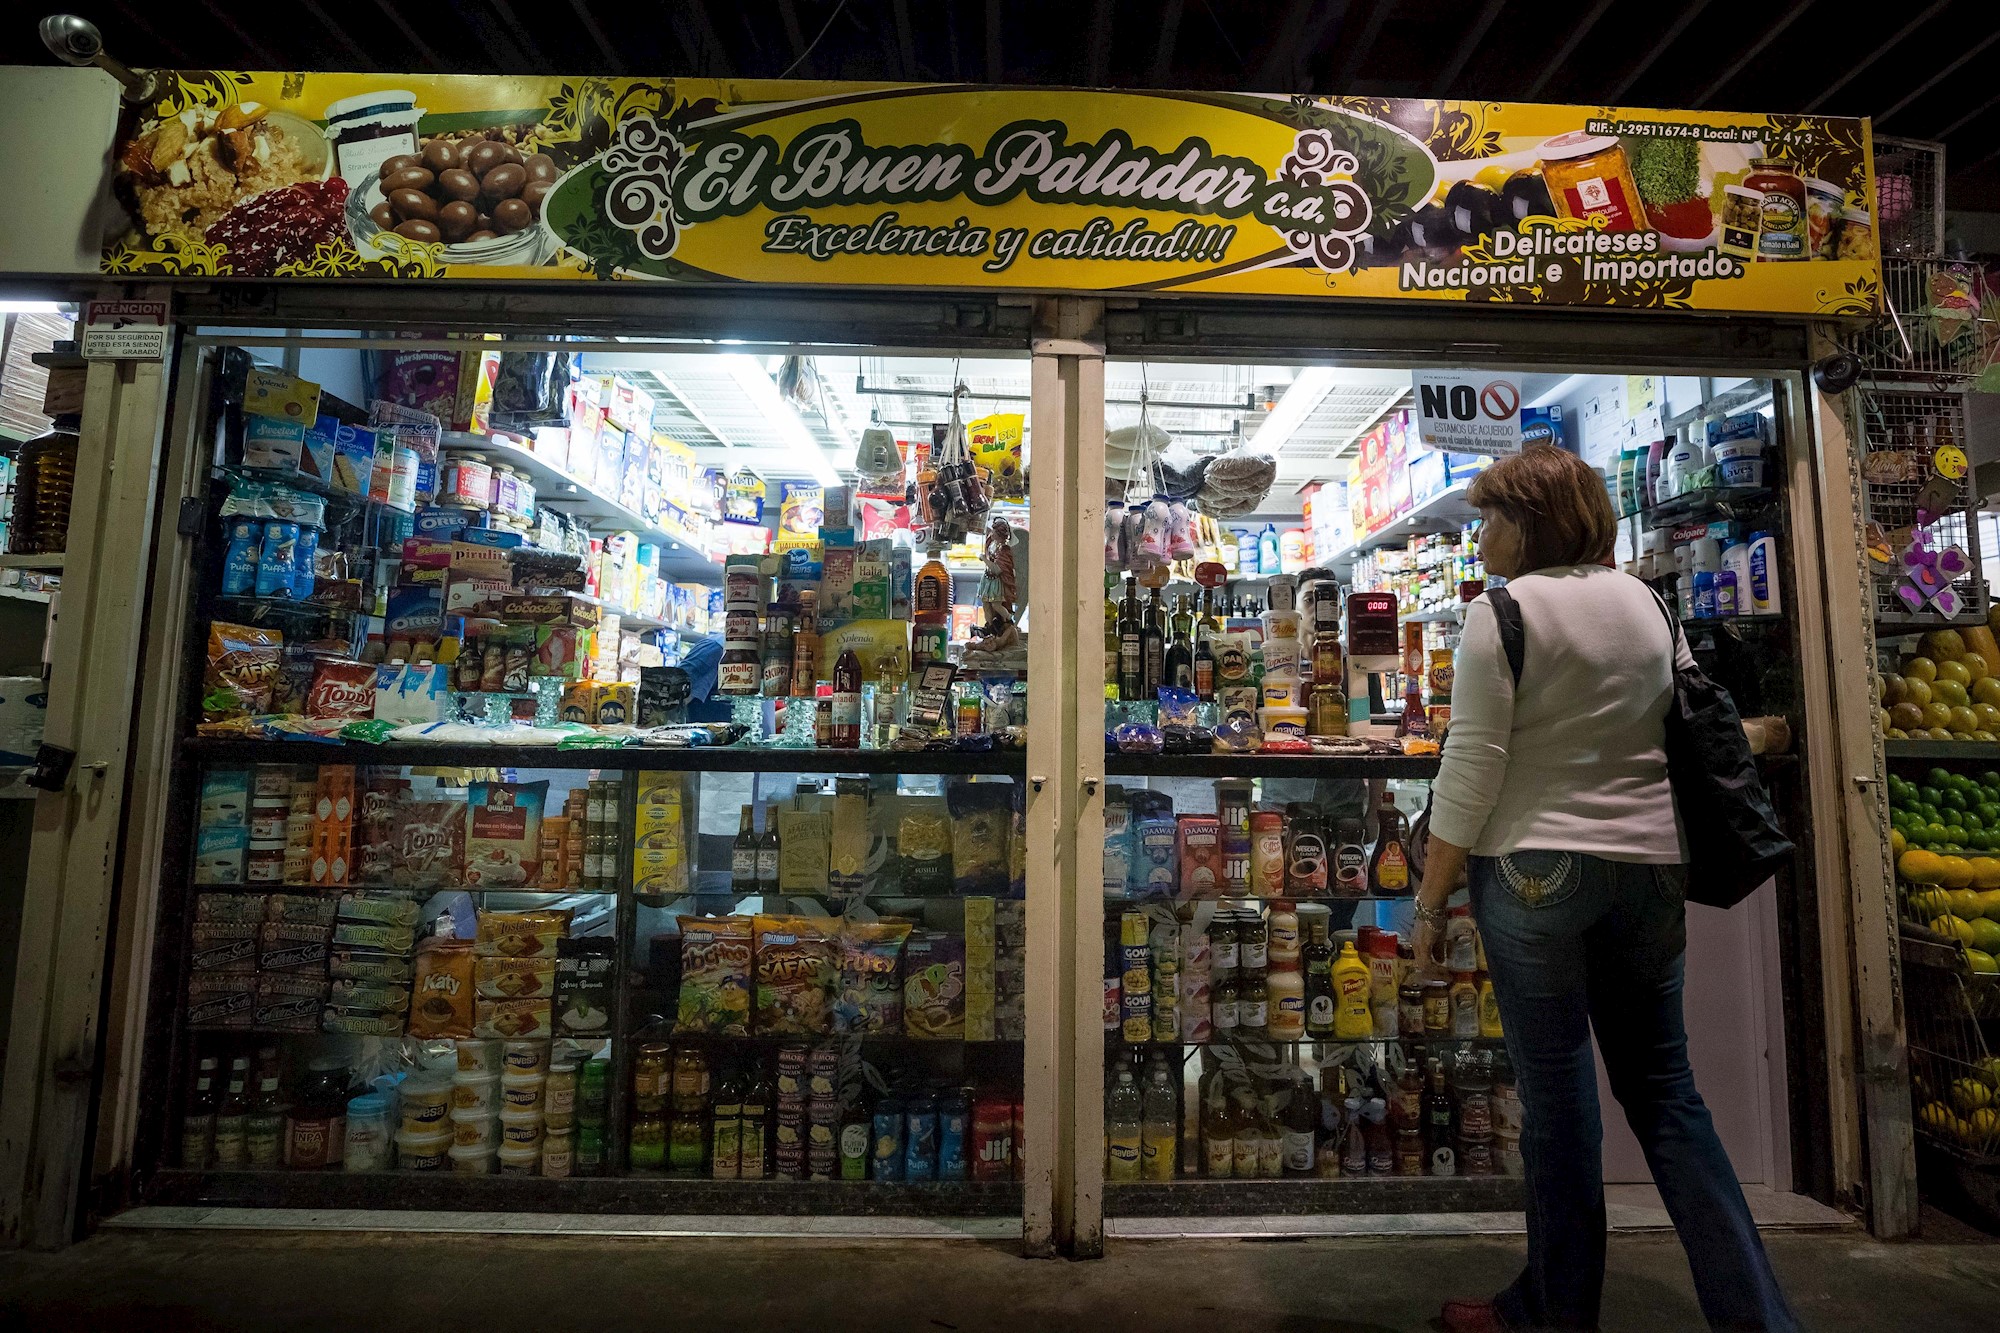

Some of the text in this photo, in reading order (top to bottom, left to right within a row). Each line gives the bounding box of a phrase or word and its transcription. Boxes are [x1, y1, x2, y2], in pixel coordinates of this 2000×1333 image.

[1617, 124, 1700, 138] J-29511674-8
[1704, 128, 1737, 140] Local:
[1765, 132, 1772, 142] L
[1784, 133, 1792, 142] 4
[1795, 134, 1802, 146] y
[1805, 133, 1813, 143] 3
[682, 140, 757, 213] El
[772, 127, 962, 200] Buen
[974, 129, 1255, 210] Paladar
[766, 216, 1235, 270] Excelencia y calidad!!!
[1494, 230, 1657, 257] Delicateses
[1403, 250, 1742, 288] Nacional e Importado.
[94, 304, 162, 315] ATENCION
[254, 376, 289, 391] Splenda
[1420, 384, 1478, 421] NO
[1434, 422, 1513, 437] ESTAMOS DE ACUERDO
[419, 516, 468, 532] OREO
[1673, 527, 1706, 540] Colgate
[230, 562, 255, 574] Puffs
[262, 562, 287, 574] Puffs
[295, 568, 316, 580] Puff
[505, 601, 563, 615] Cocosette
[391, 616, 442, 631] OREO
[837, 631, 874, 645] Splenda
[914, 635, 941, 653] Jif
[723, 663, 753, 673] nutella
[320, 684, 376, 708] TODDY
[487, 805, 514, 813] QUAKER
[1222, 807, 1249, 826] Jif
[1142, 827, 1177, 836] DAAWAT
[1185, 826, 1219, 835] DAAWAT
[1223, 859, 1250, 879] Jif
[421, 973, 461, 996] Katy
[980, 1137, 1012, 1162] Jif
[946, 1159, 966, 1169] Puff
